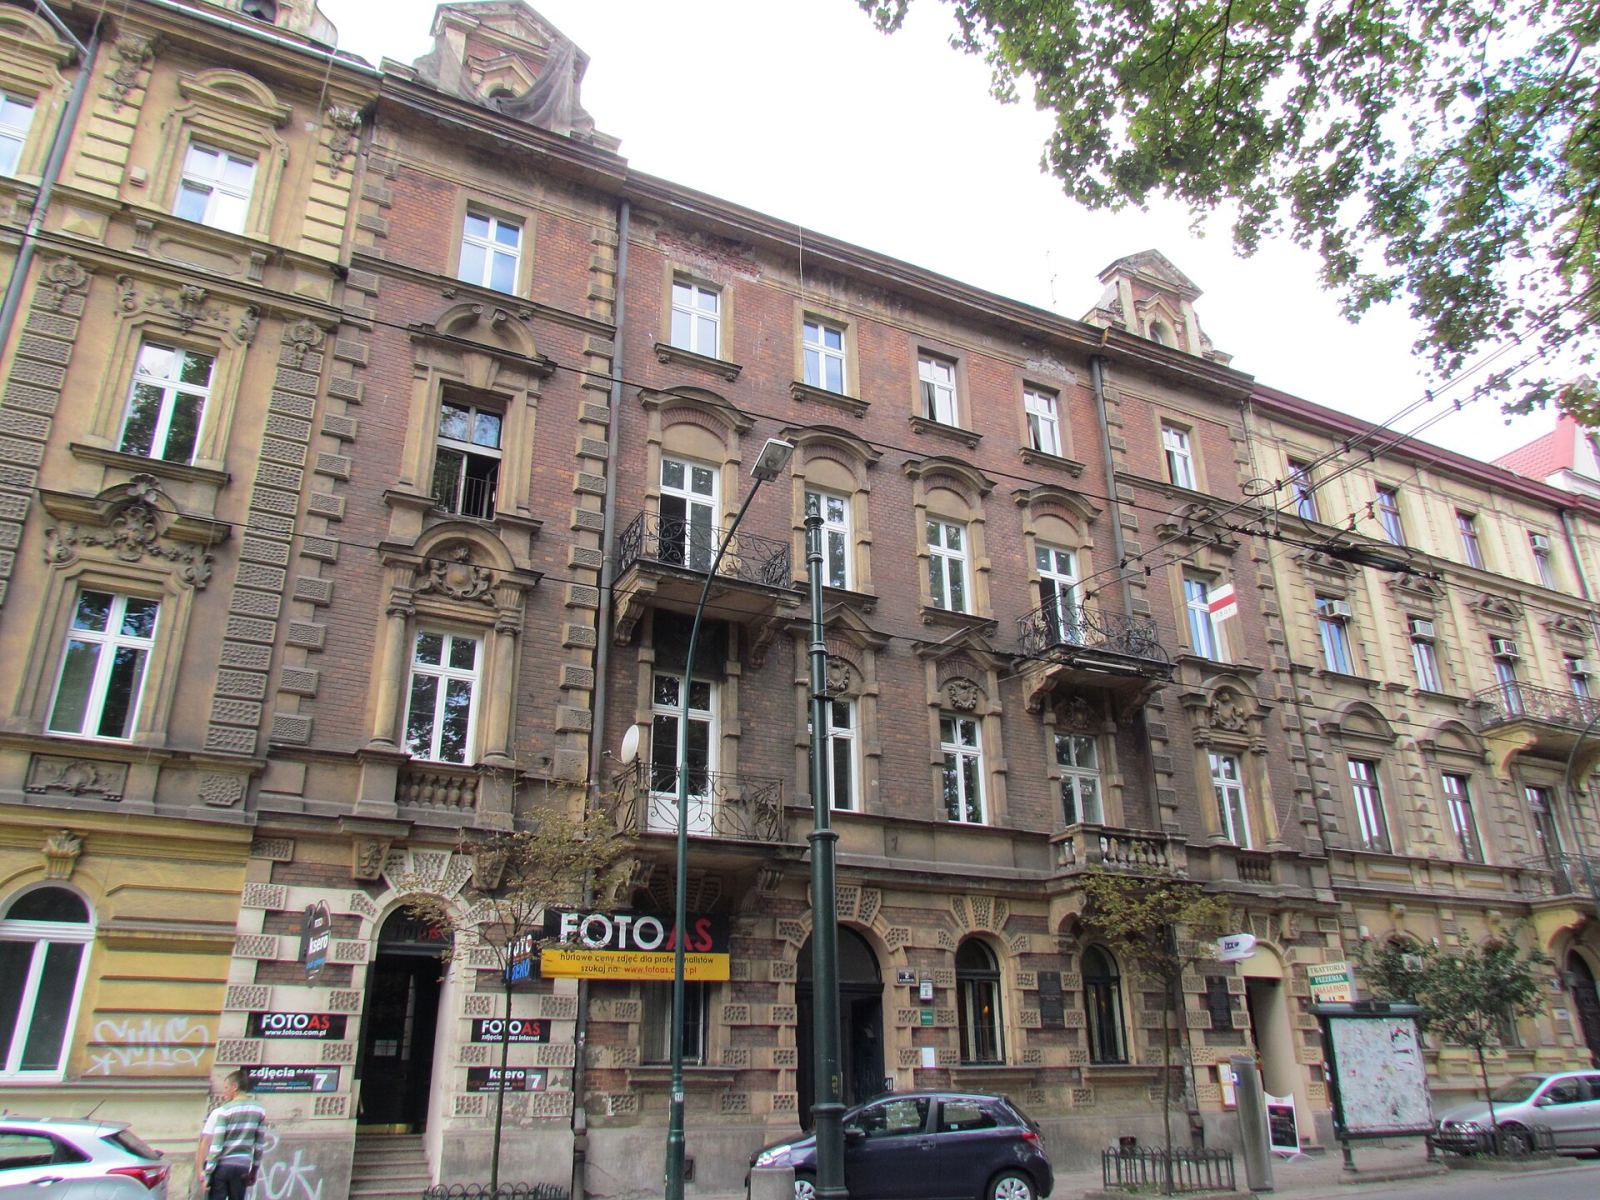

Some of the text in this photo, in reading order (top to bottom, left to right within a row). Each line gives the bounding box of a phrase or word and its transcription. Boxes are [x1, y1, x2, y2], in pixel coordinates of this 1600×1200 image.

[560, 913, 713, 951] FOTOAS
[308, 934, 329, 956] ksero
[560, 953, 593, 961] hurtowe
[654, 957, 714, 965] profenalistów
[581, 965, 606, 974] szukaj
[624, 967, 697, 975] www.fotoas.cpl
[1314, 974, 1344, 983] PIZZERIA
[261, 1014, 330, 1029] FOTOAS
[249, 1066, 296, 1079] zdjęcia
[489, 1068, 525, 1080] ksero
[315, 1073, 329, 1090] 7
[530, 1074, 542, 1089] 7
